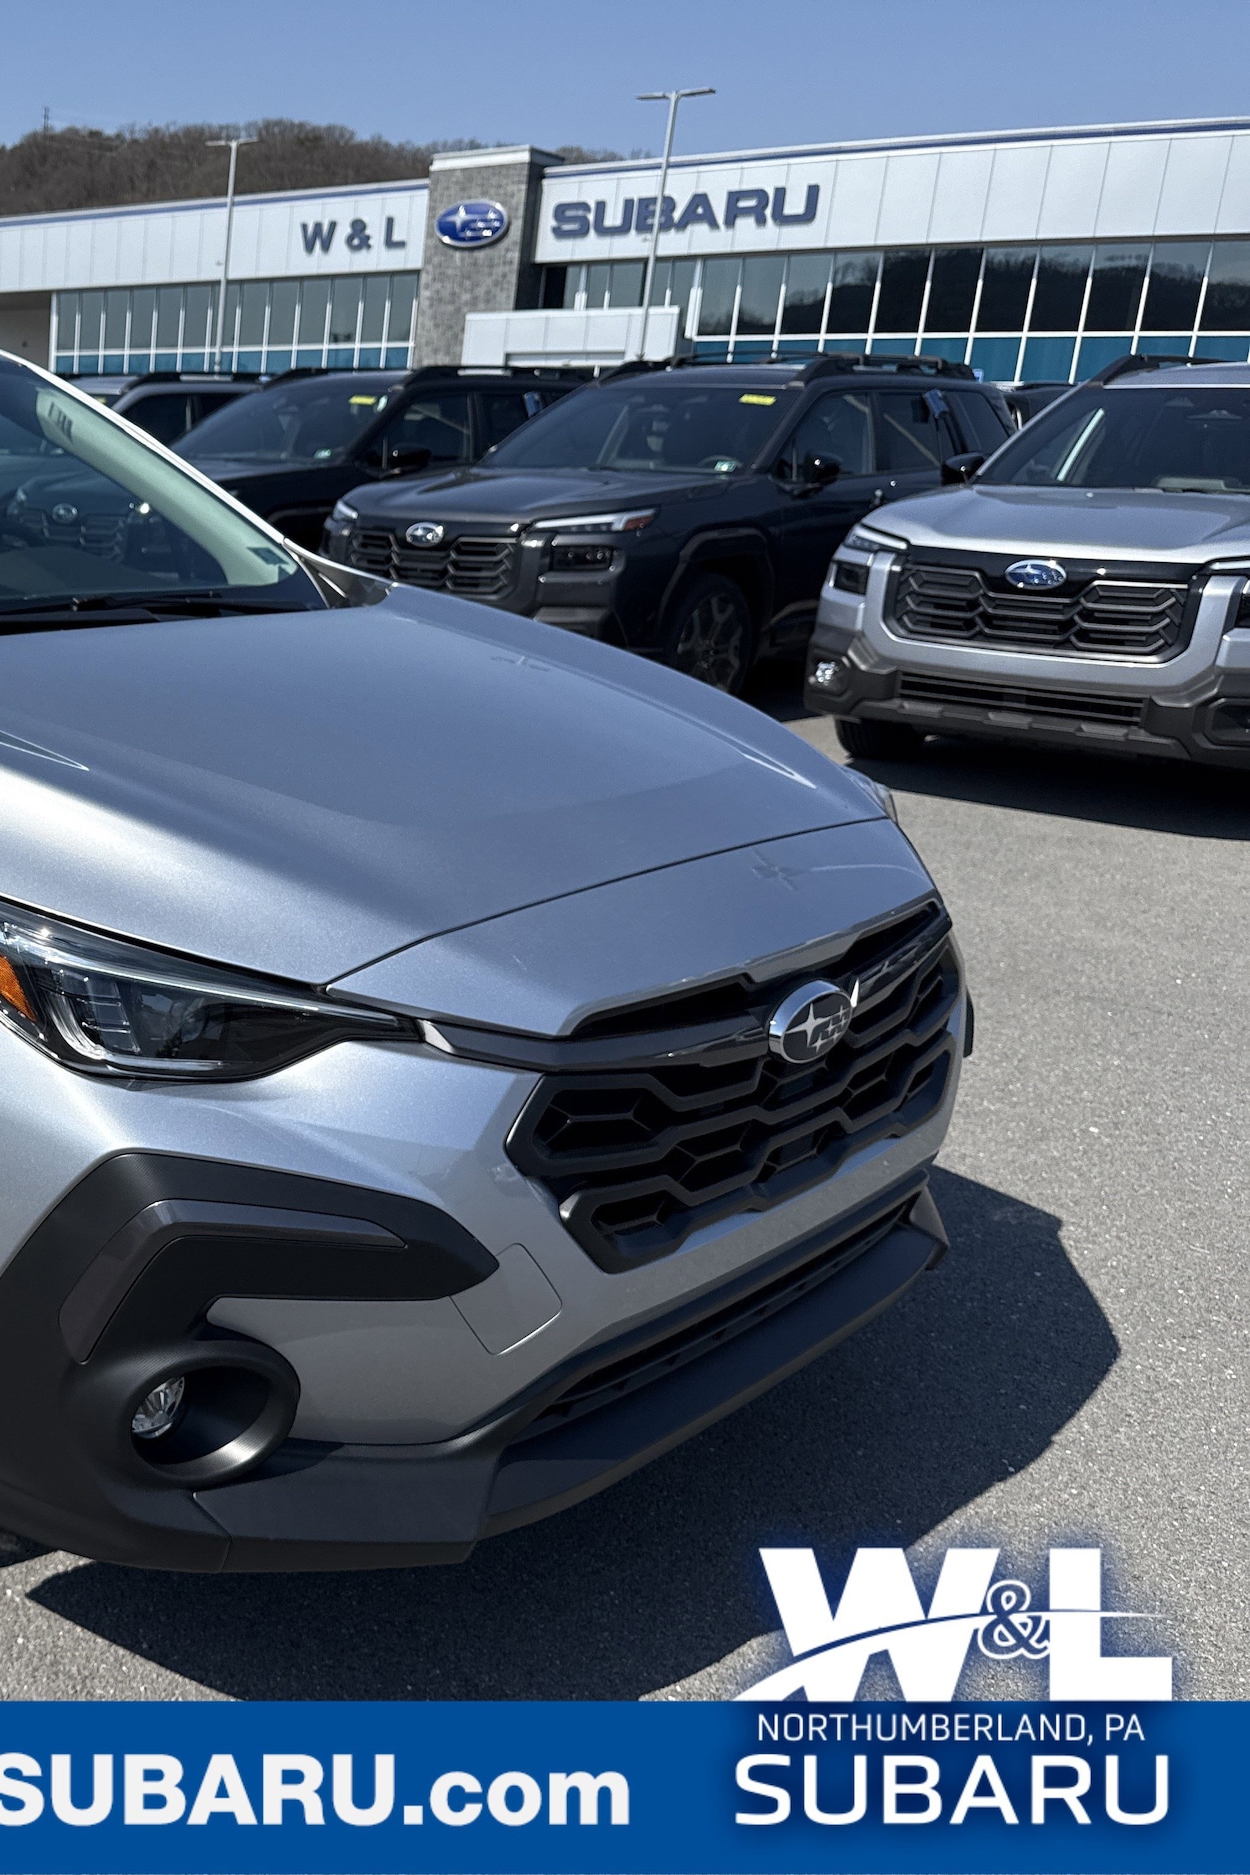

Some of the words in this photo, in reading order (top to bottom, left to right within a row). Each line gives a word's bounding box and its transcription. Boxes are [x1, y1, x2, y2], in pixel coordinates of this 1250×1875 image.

[301, 220, 337, 254] W
[345, 218, 372, 251] &
[384, 215, 406, 249] L
[551, 183, 820, 239] SUBARU
